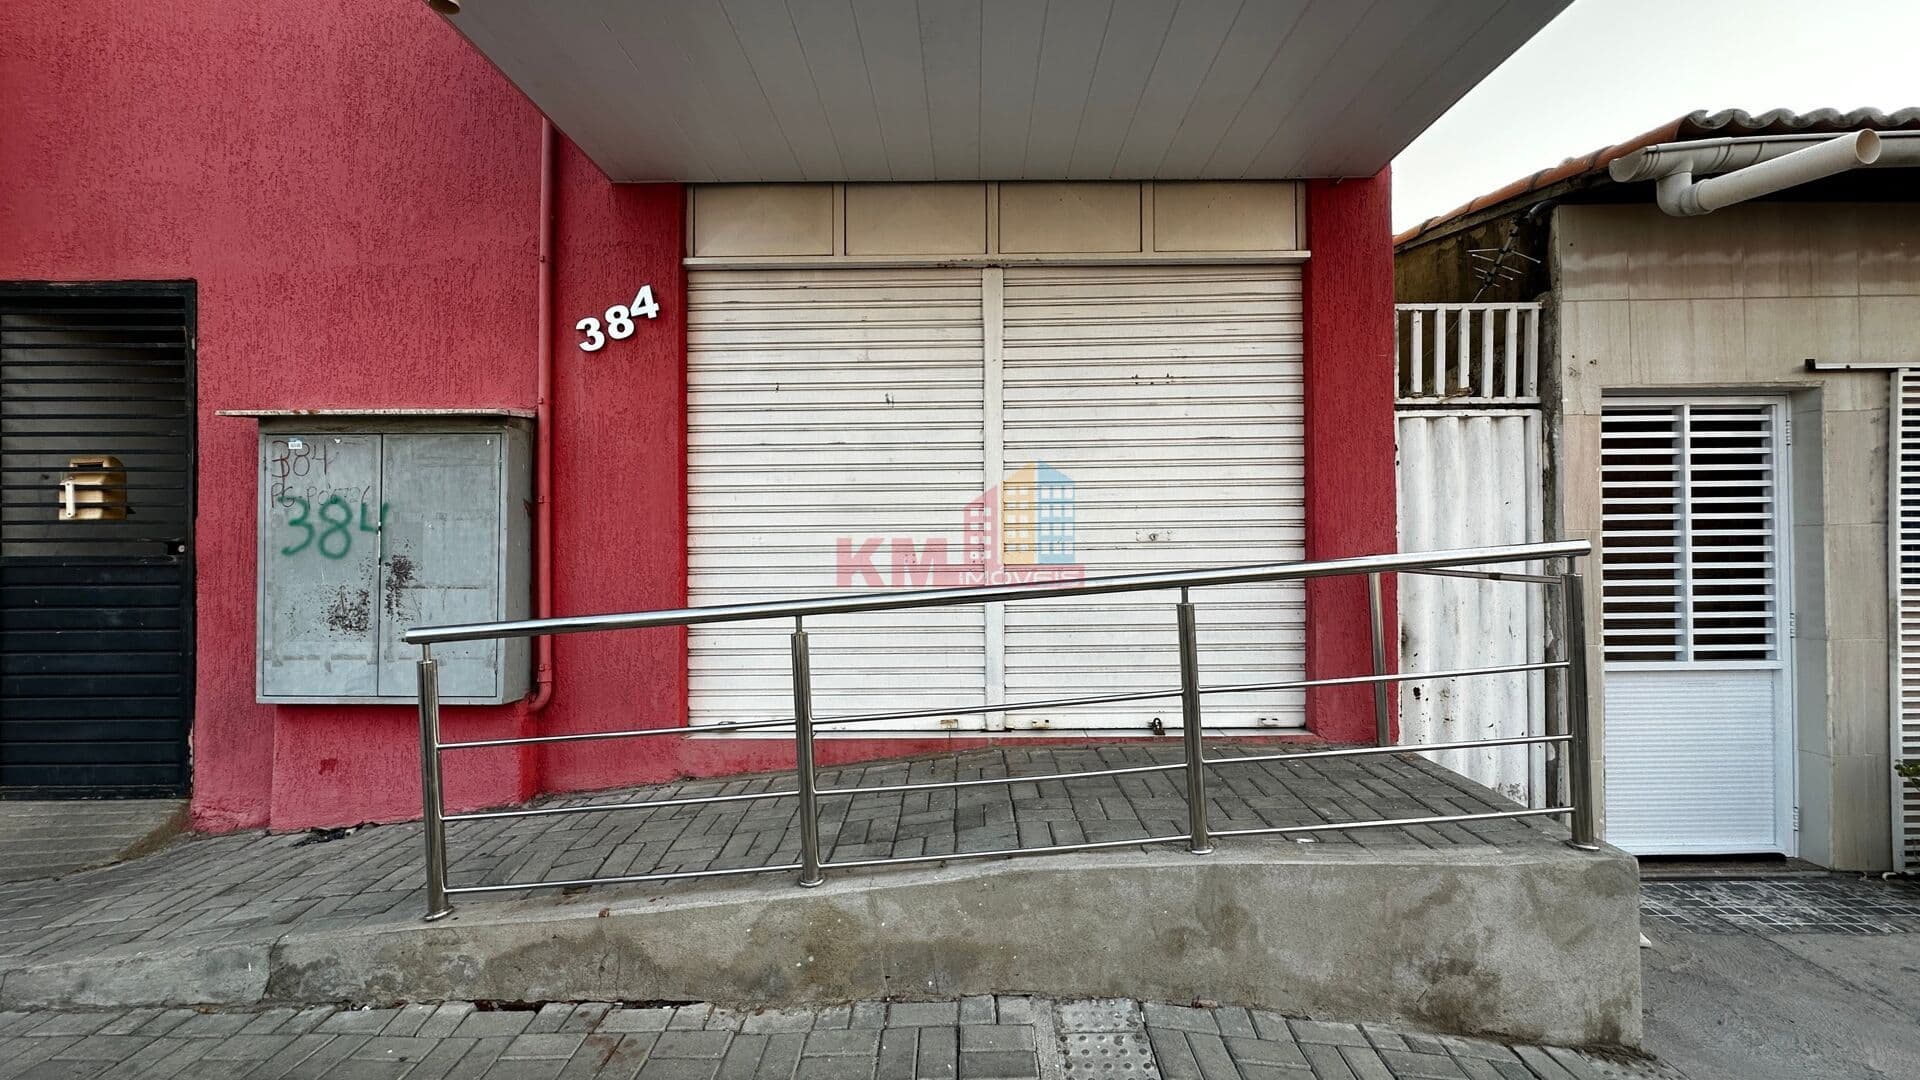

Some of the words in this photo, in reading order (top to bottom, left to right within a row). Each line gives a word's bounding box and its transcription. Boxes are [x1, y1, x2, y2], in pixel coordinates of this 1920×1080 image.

[576, 285, 660, 352] 384
[271, 440, 328, 478] 384
[277, 495, 390, 560] 384
